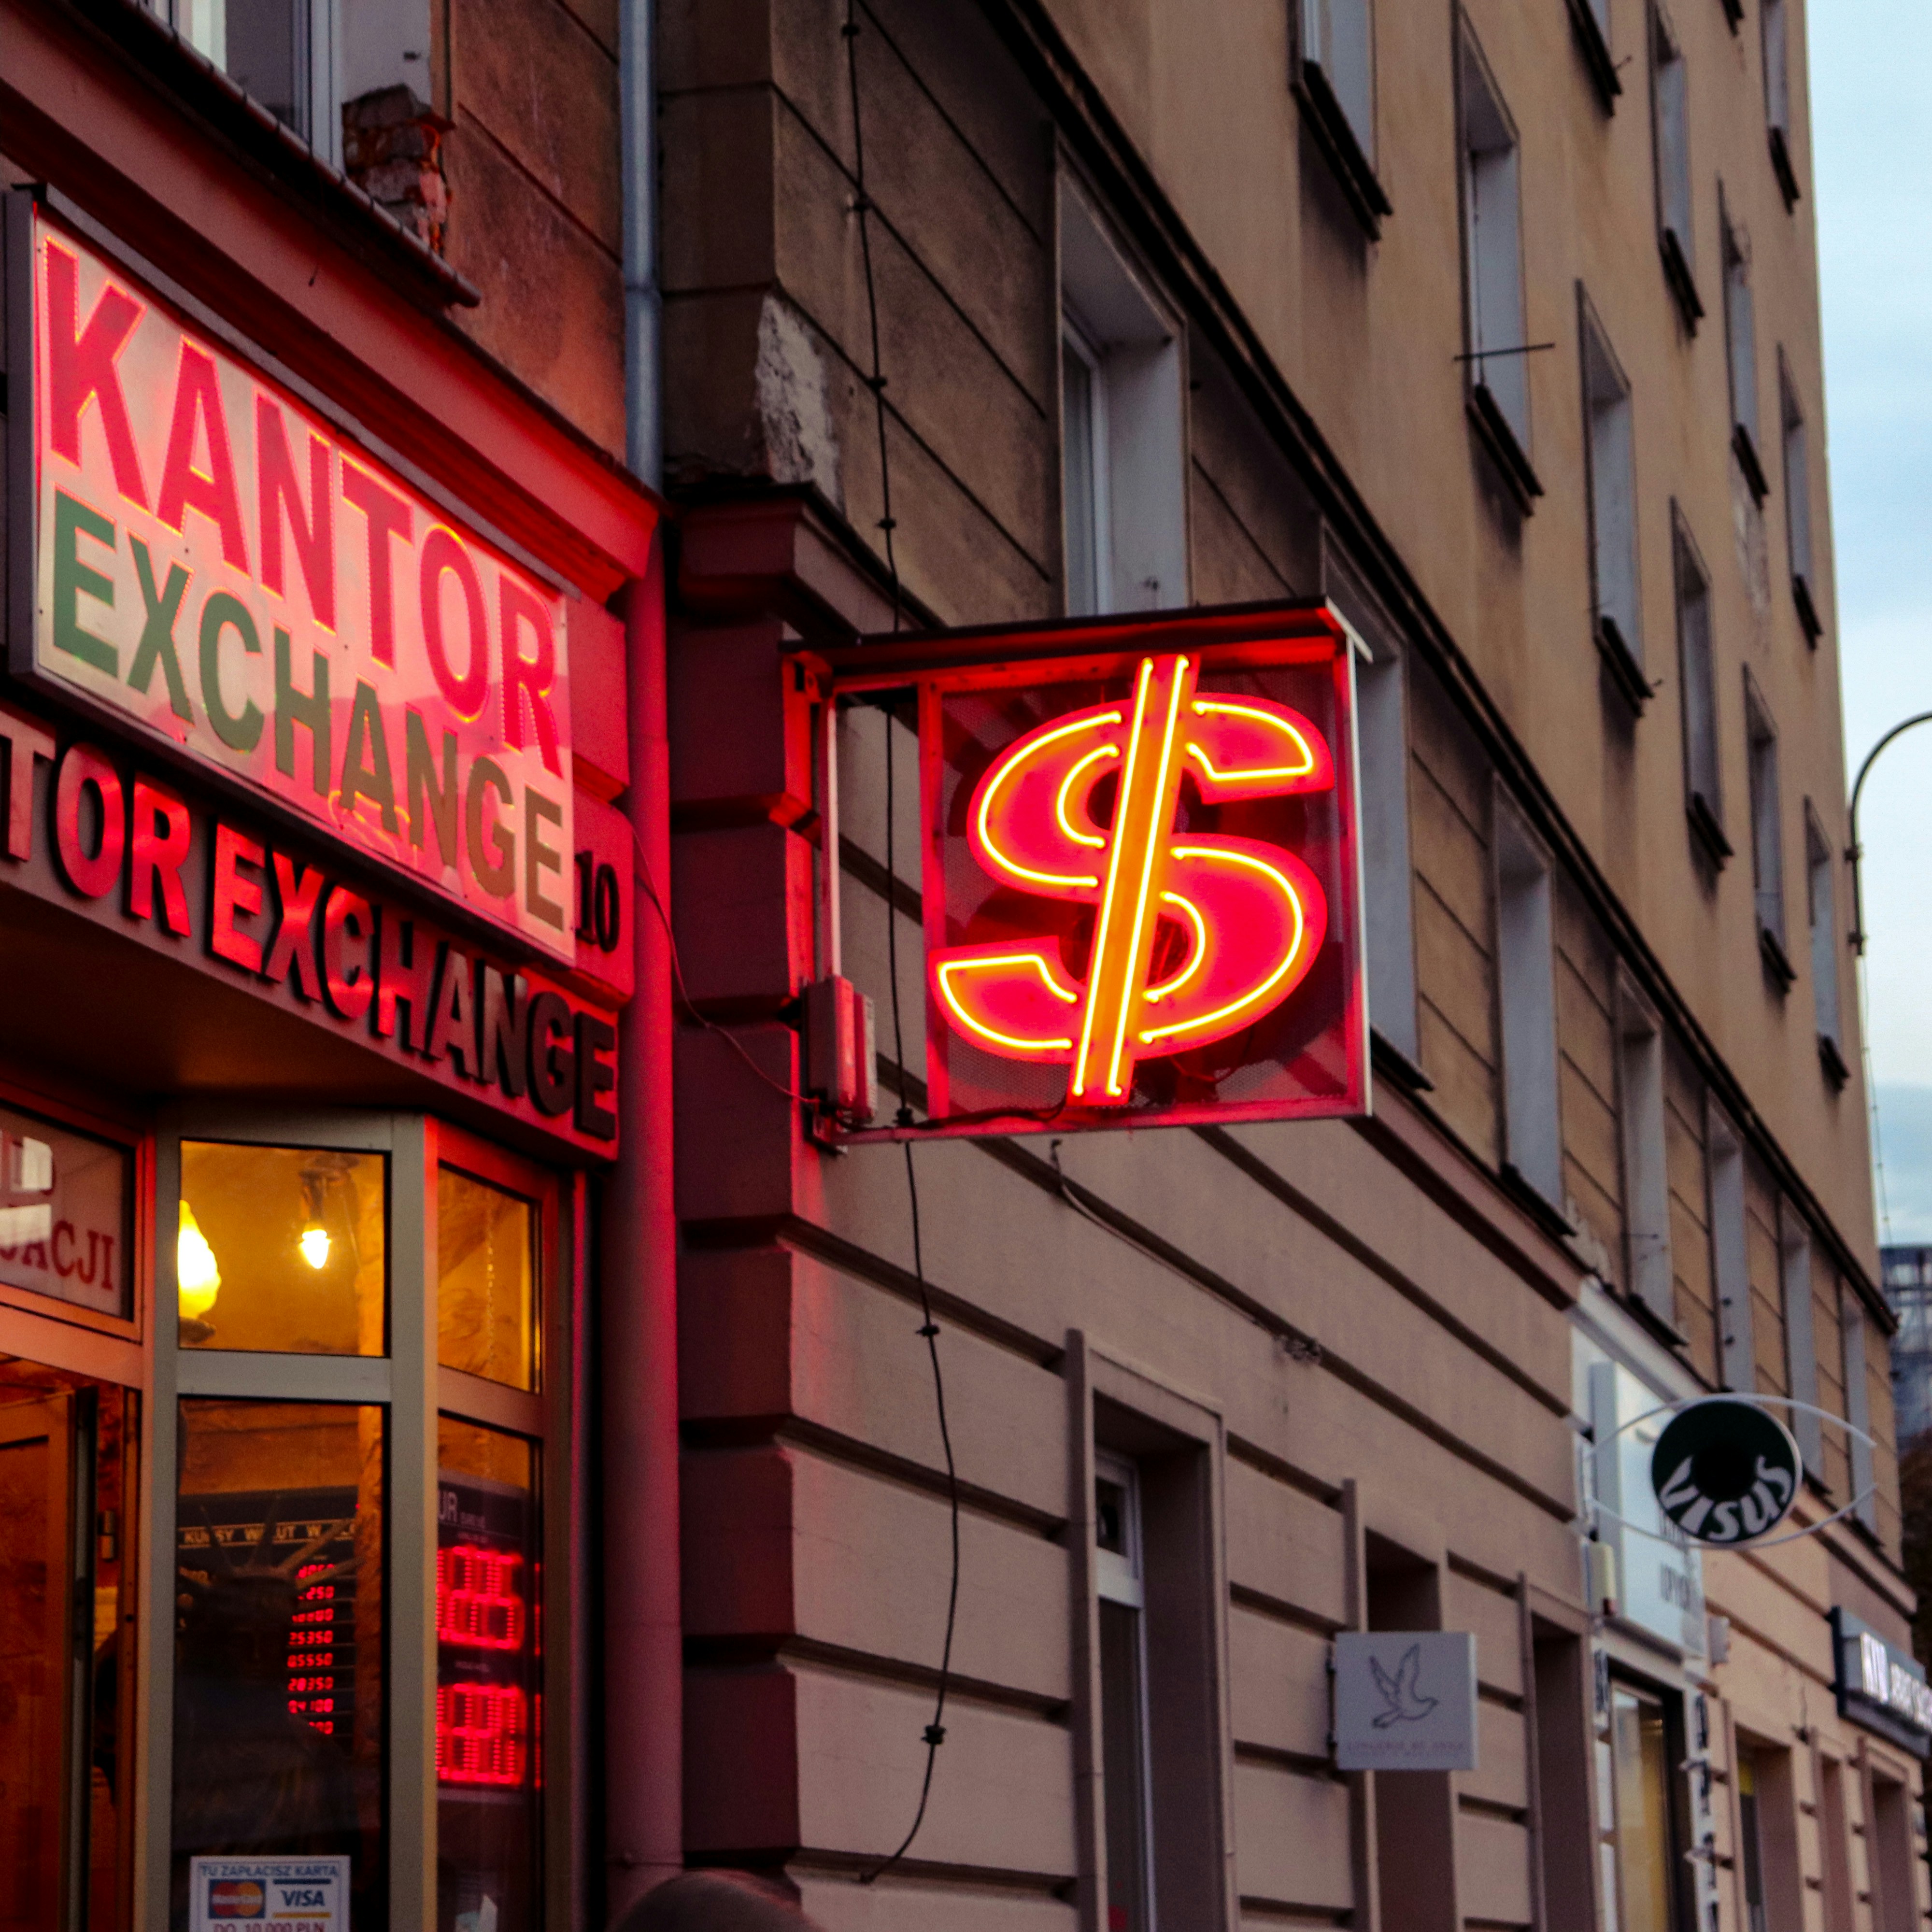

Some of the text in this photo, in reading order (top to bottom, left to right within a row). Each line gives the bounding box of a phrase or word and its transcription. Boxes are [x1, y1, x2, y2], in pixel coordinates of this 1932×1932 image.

[44, 235, 563, 779] KANTOR
[55, 483, 564, 932] EXCHANGE
[0, 707, 616, 1141] TOR EXCHANGE
[0, 1220, 114, 1291] ACJI
[1659, 1453, 1792, 1541] VISUS
[281, 1889, 325, 1906] VISA
